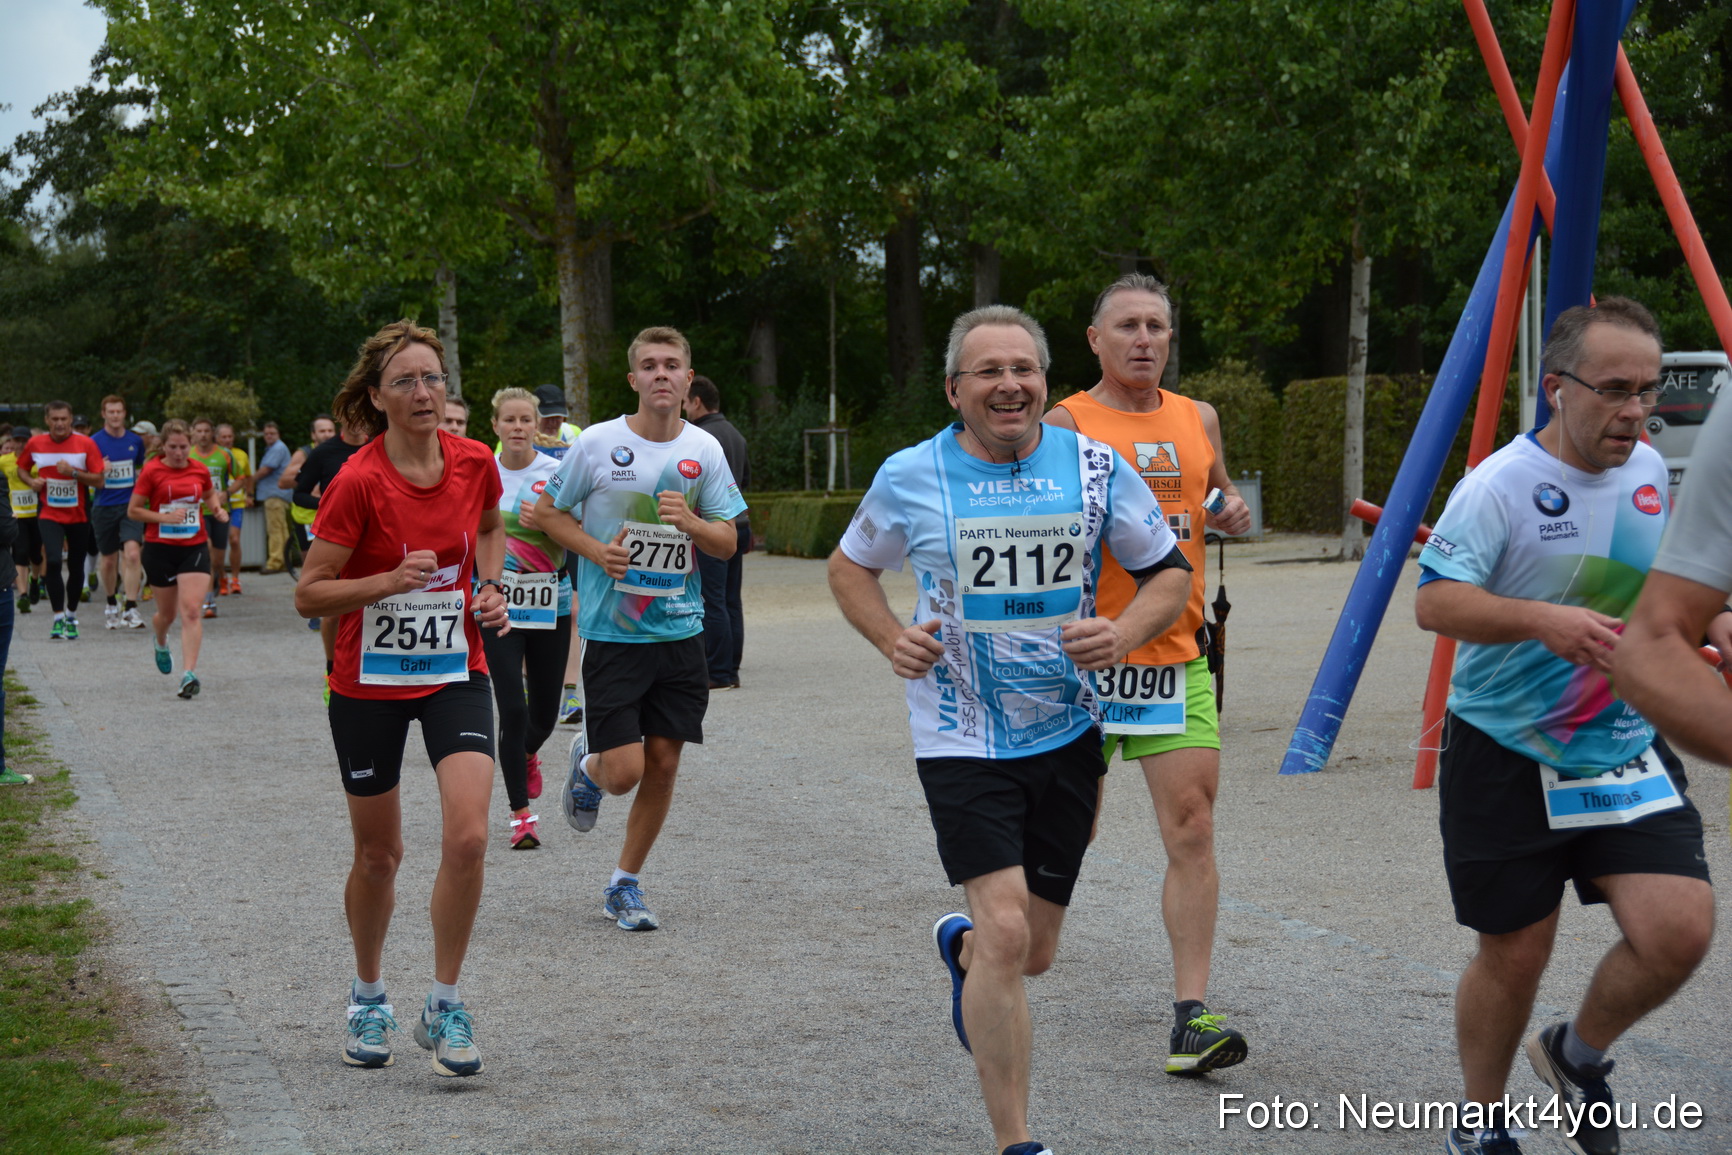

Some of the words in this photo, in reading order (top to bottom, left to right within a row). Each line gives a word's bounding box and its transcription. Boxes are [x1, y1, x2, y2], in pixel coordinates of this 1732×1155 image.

[107, 467, 131, 478] 2511
[49, 486, 75, 497] 2095
[967, 478, 1062, 495] VIERTL
[969, 496, 1022, 507] DESIGN
[1025, 493, 1065, 504] GmbH
[1086, 473, 1101, 538] VIERTL
[627, 528, 651, 538] PARTL
[653, 531, 684, 540] Neumarkt
[960, 528, 1002, 540] PARTL
[1005, 527, 1065, 539] Neumarkt
[1539, 522, 1578, 535] PARTL
[1540, 531, 1580, 543] Neumarkt
[629, 540, 686, 570] 2778
[972, 543, 1074, 587] 2112
[500, 574, 516, 584] ARTL
[517, 577, 547, 585] Neumarkt
[639, 574, 672, 587] Paulus
[404, 601, 452, 612] Neumarkt
[1004, 600, 1045, 616] Hans
[374, 615, 459, 651] 2547
[400, 658, 432, 672] Gabi
[995, 661, 1063, 677] raumbox
[1097, 666, 1176, 700] 3090
[1102, 703, 1147, 722] KURT
[1579, 790, 1642, 809] Thomas
